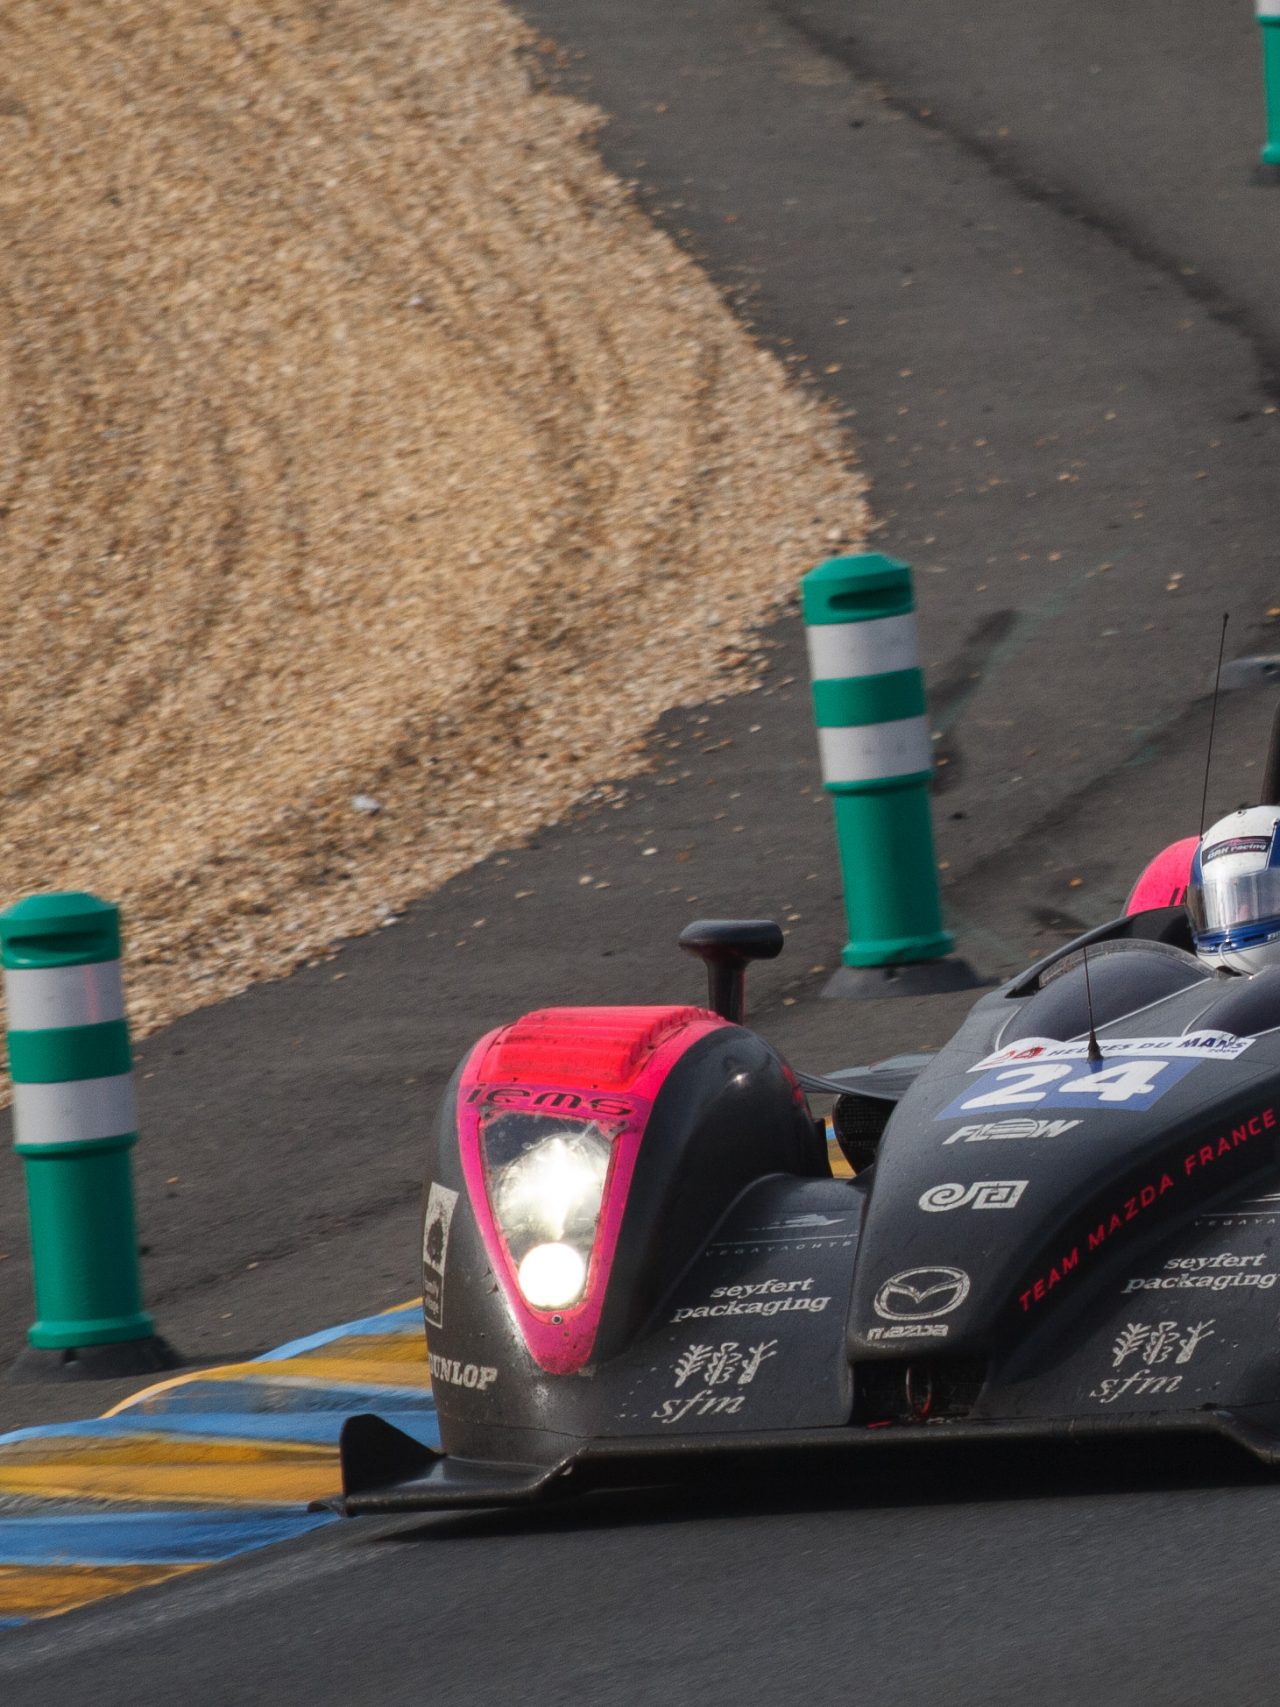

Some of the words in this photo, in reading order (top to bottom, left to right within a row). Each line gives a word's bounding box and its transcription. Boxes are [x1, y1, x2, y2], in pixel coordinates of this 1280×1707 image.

[1177, 1036, 1247, 1050] MANS
[960, 1060, 1169, 1110] 24
[466, 1085, 634, 1116] iems
[1018, 1247, 1079, 1311] TEAM
[1087, 1173, 1174, 1250] MAZDA
[1184, 1108, 1276, 1177] FRANCE
[1163, 1252, 1267, 1271] seyfert
[709, 1277, 815, 1299] seyfert
[1121, 1272, 1280, 1294] packaging
[669, 1296, 832, 1323] packaging
[1089, 1370, 1183, 1404] sfm
[651, 1389, 746, 1424] sfm
